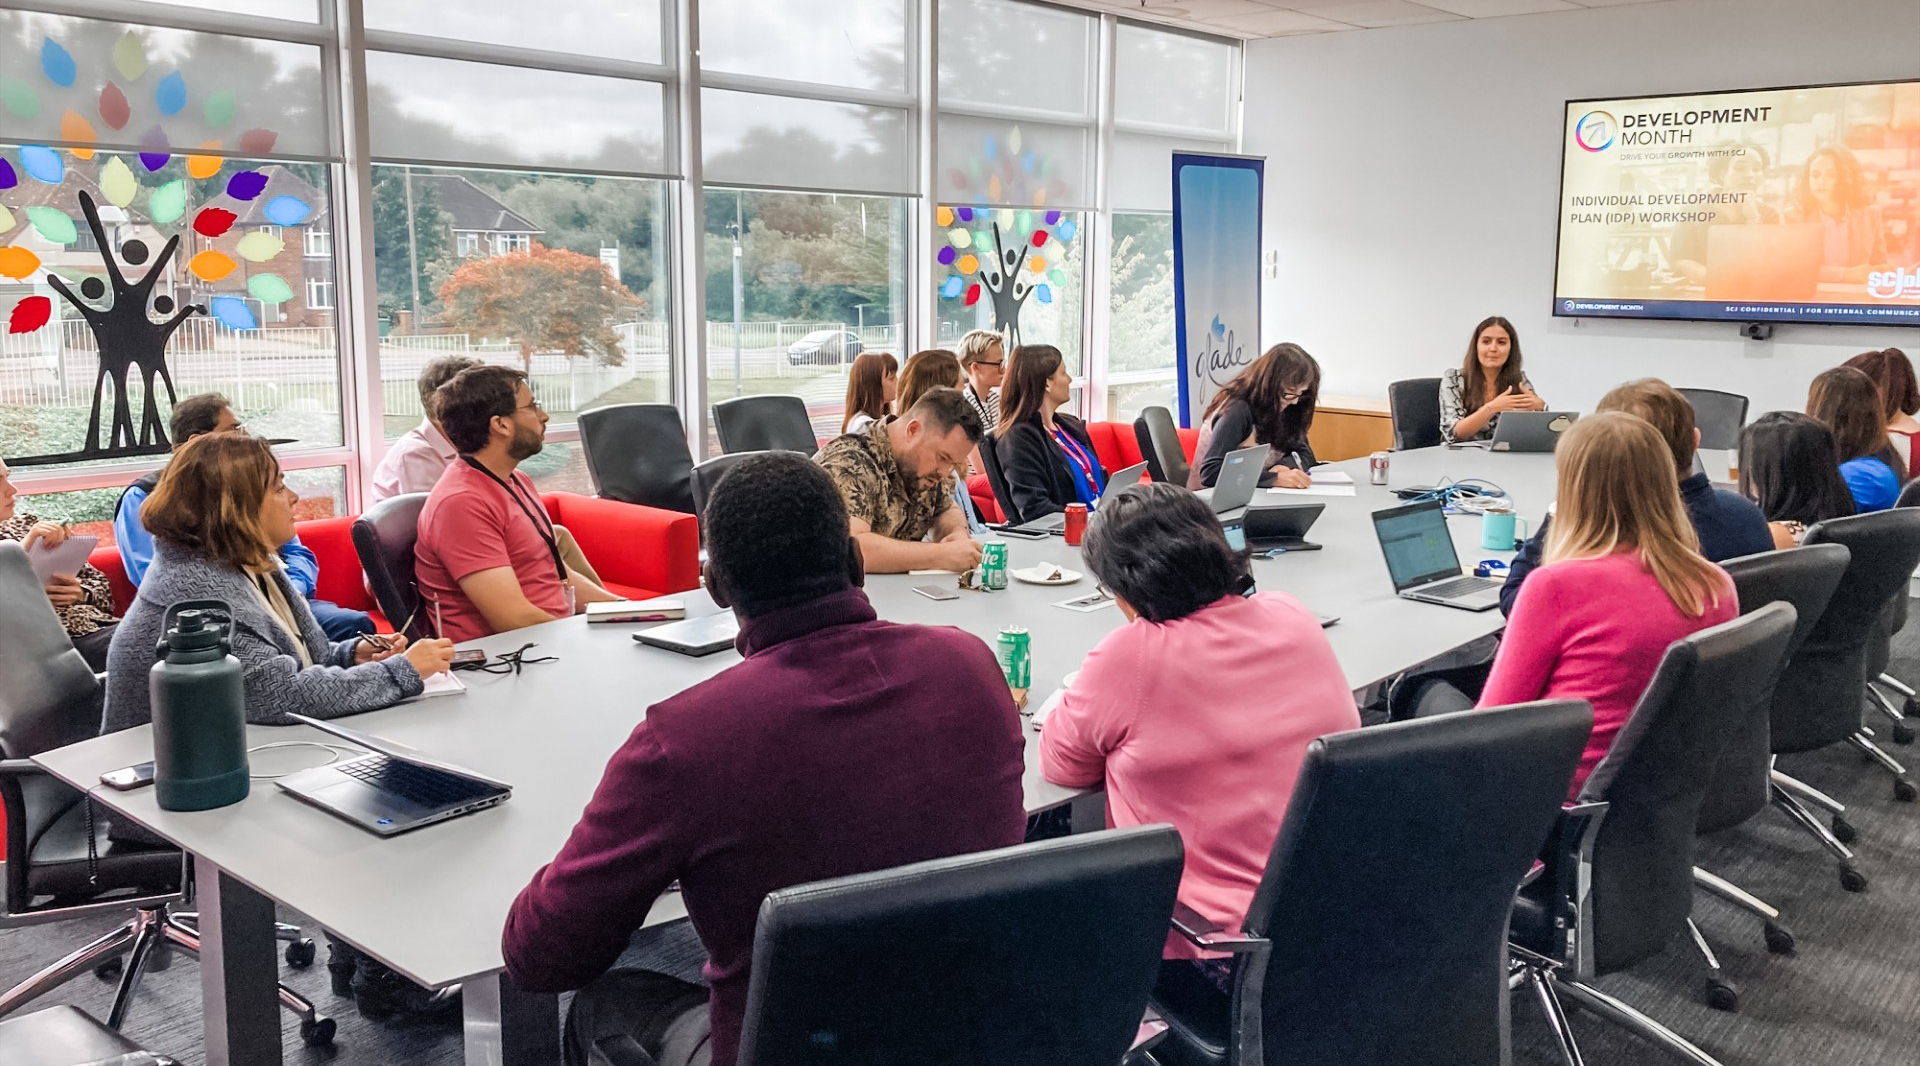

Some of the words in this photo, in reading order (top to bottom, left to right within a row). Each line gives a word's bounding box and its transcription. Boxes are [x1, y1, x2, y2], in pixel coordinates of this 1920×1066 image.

[1623, 106, 1772, 128] DEVELOPMENT
[1621, 129, 1693, 146] MONTH
[1620, 153, 1643, 161] DRIVE
[1645, 152, 1666, 160] YOUR
[1667, 151, 1705, 159] GROWTH
[1707, 150, 1729, 158] WITH
[1730, 149, 1746, 157] SCJ
[1571, 195, 1645, 207] INDIVIDUAL
[1647, 192, 1748, 206] DEVELOPMENT
[1570, 213, 1602, 224] PLAN
[1605, 212, 1635, 225] (IDP)
[1639, 211, 1716, 223] WORKSHOP
[1575, 303, 1619, 311] DEVELOPMENT
[1740, 306, 1796, 314] CONFIDENTIAL
[1806, 307, 1822, 315] FOR
[1195, 329, 1252, 405] glade
